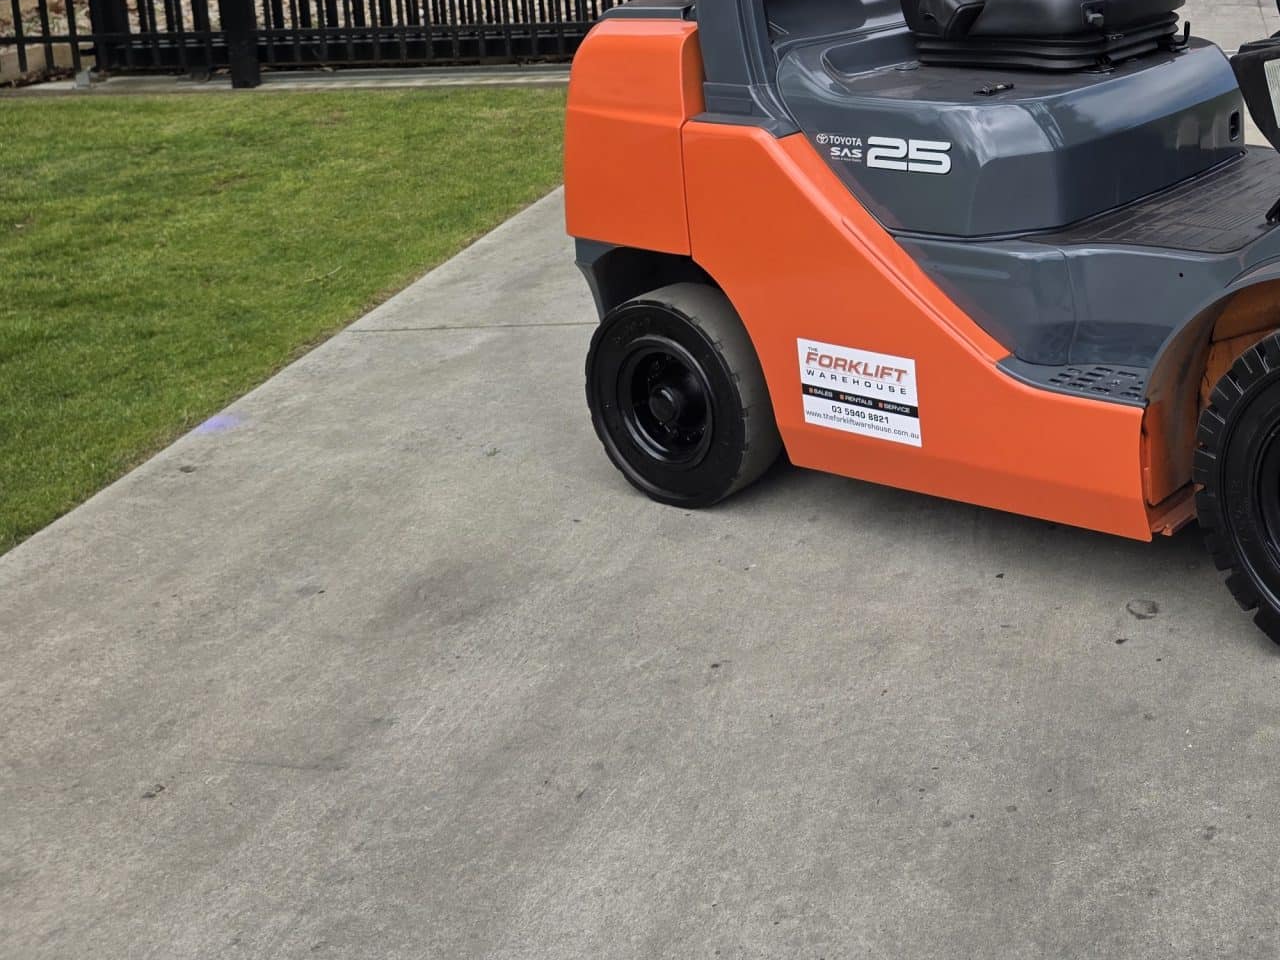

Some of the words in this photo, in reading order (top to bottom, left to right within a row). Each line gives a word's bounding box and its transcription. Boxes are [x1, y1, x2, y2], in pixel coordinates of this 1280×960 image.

[828, 135, 863, 147] TOYOTA
[866, 136, 952, 175] 25
[830, 146, 863, 158] SAS
[806, 352, 907, 382] FORKLIFT
[806, 369, 907, 395] WAREHOUSE
[813, 387, 833, 398] SALES
[844, 394, 873, 406] RENTALS
[883, 403, 911, 414] SERVICE
[805, 409, 920, 439] www.theforkliftwarehouse.com.au
[831, 405, 842, 414] 03
[844, 407, 866, 419] 5940
[868, 413, 889, 424] 8821
